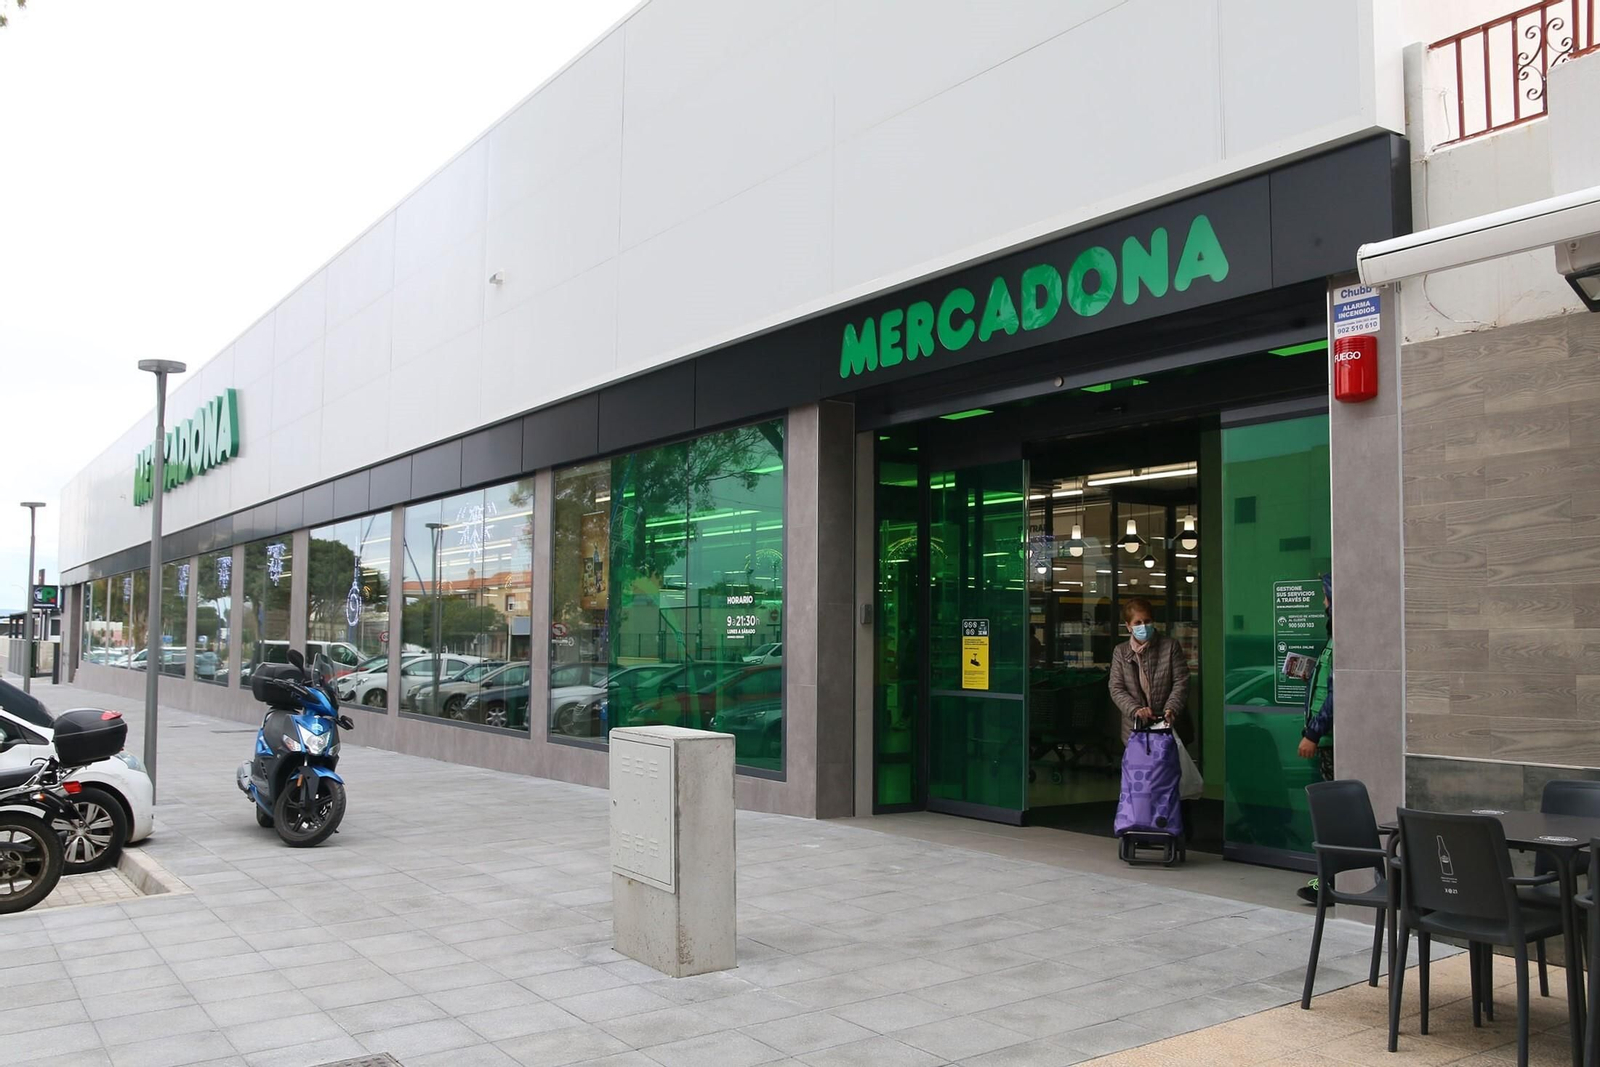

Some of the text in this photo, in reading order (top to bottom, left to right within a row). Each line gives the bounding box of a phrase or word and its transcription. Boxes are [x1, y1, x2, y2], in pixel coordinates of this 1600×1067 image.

[840, 214, 1229, 378] MERCADONA
[1340, 286, 1372, 299] Chubb
[1338, 306, 1376, 319] INCENDIOS
[1342, 300, 1370, 312] ALARMA
[1337, 326, 1350, 335] 902
[1351, 323, 1363, 332] 510
[1364, 321, 1378, 329] 610
[1334, 351, 1361, 363] FUEGO
[726, 595, 754, 604] HORARIO
